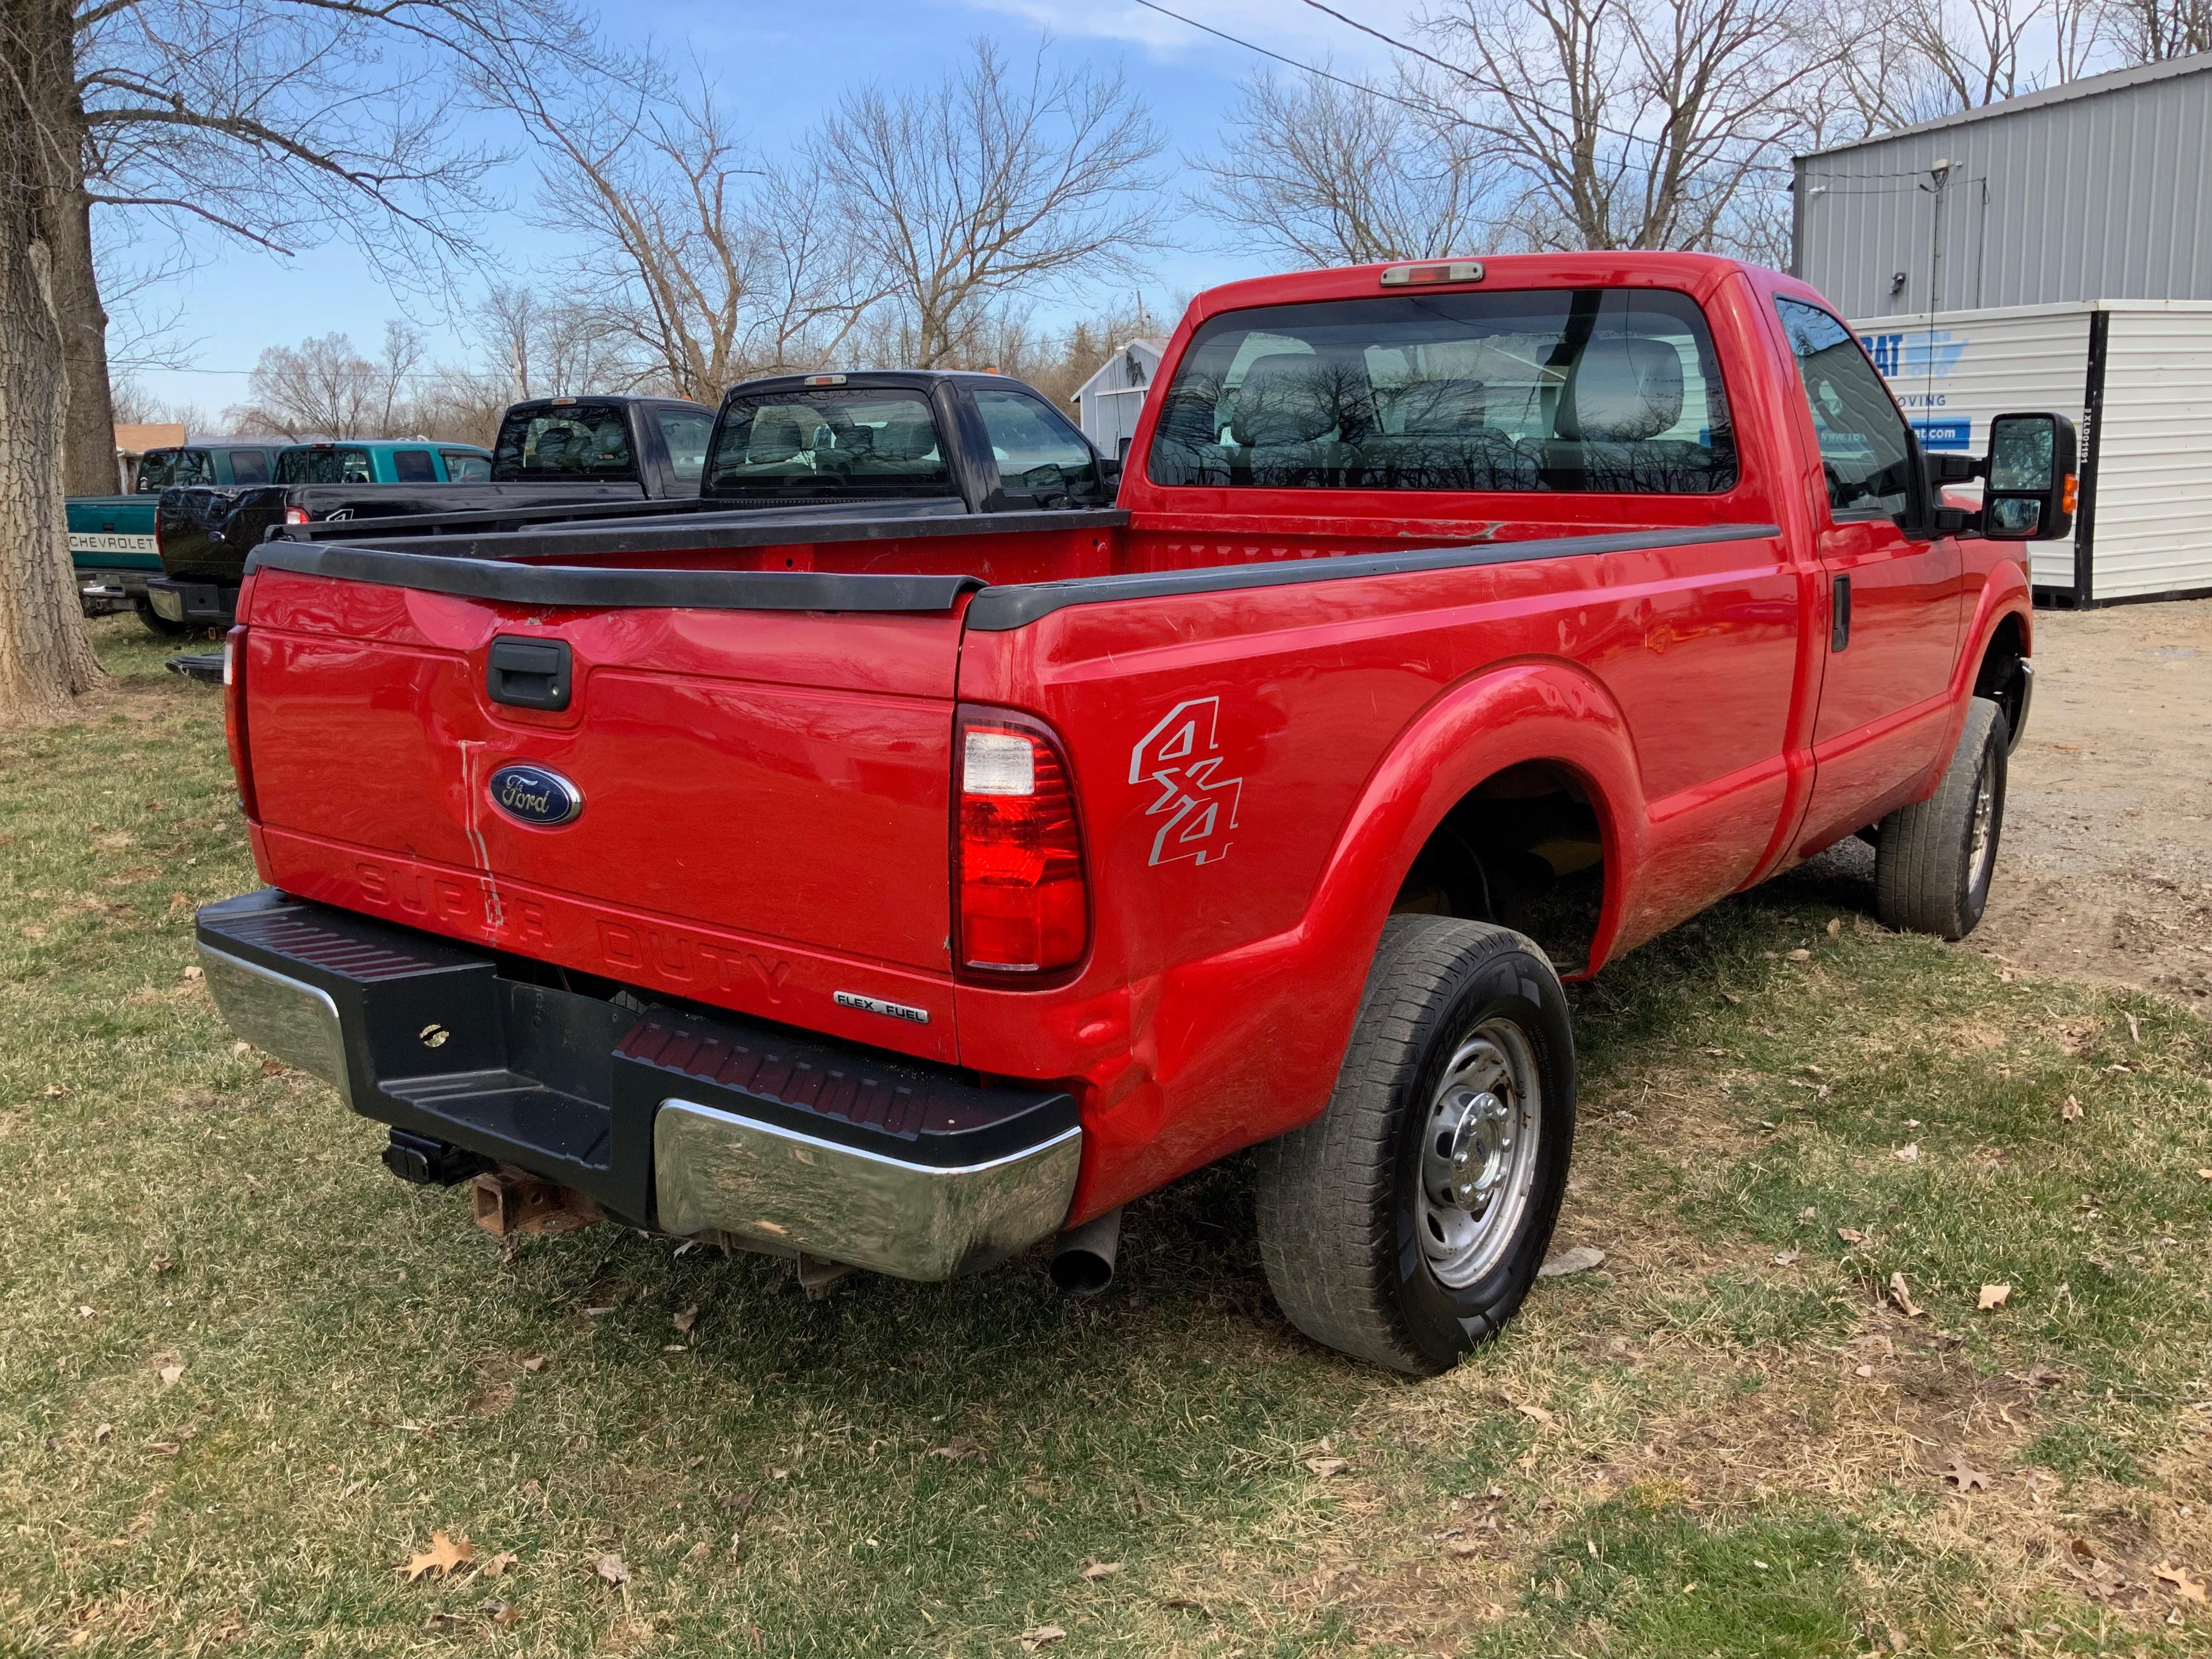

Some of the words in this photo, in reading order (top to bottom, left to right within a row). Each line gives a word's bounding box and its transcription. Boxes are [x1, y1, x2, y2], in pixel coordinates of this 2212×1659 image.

[69, 536, 153, 549] CHEVROLET
[502, 775, 550, 814] Ford
[355, 862, 554, 947] SUPER
[597, 919, 790, 1003] DUTY
[838, 995, 874, 1010] FLEX
[885, 1005, 924, 1022] FUEL
